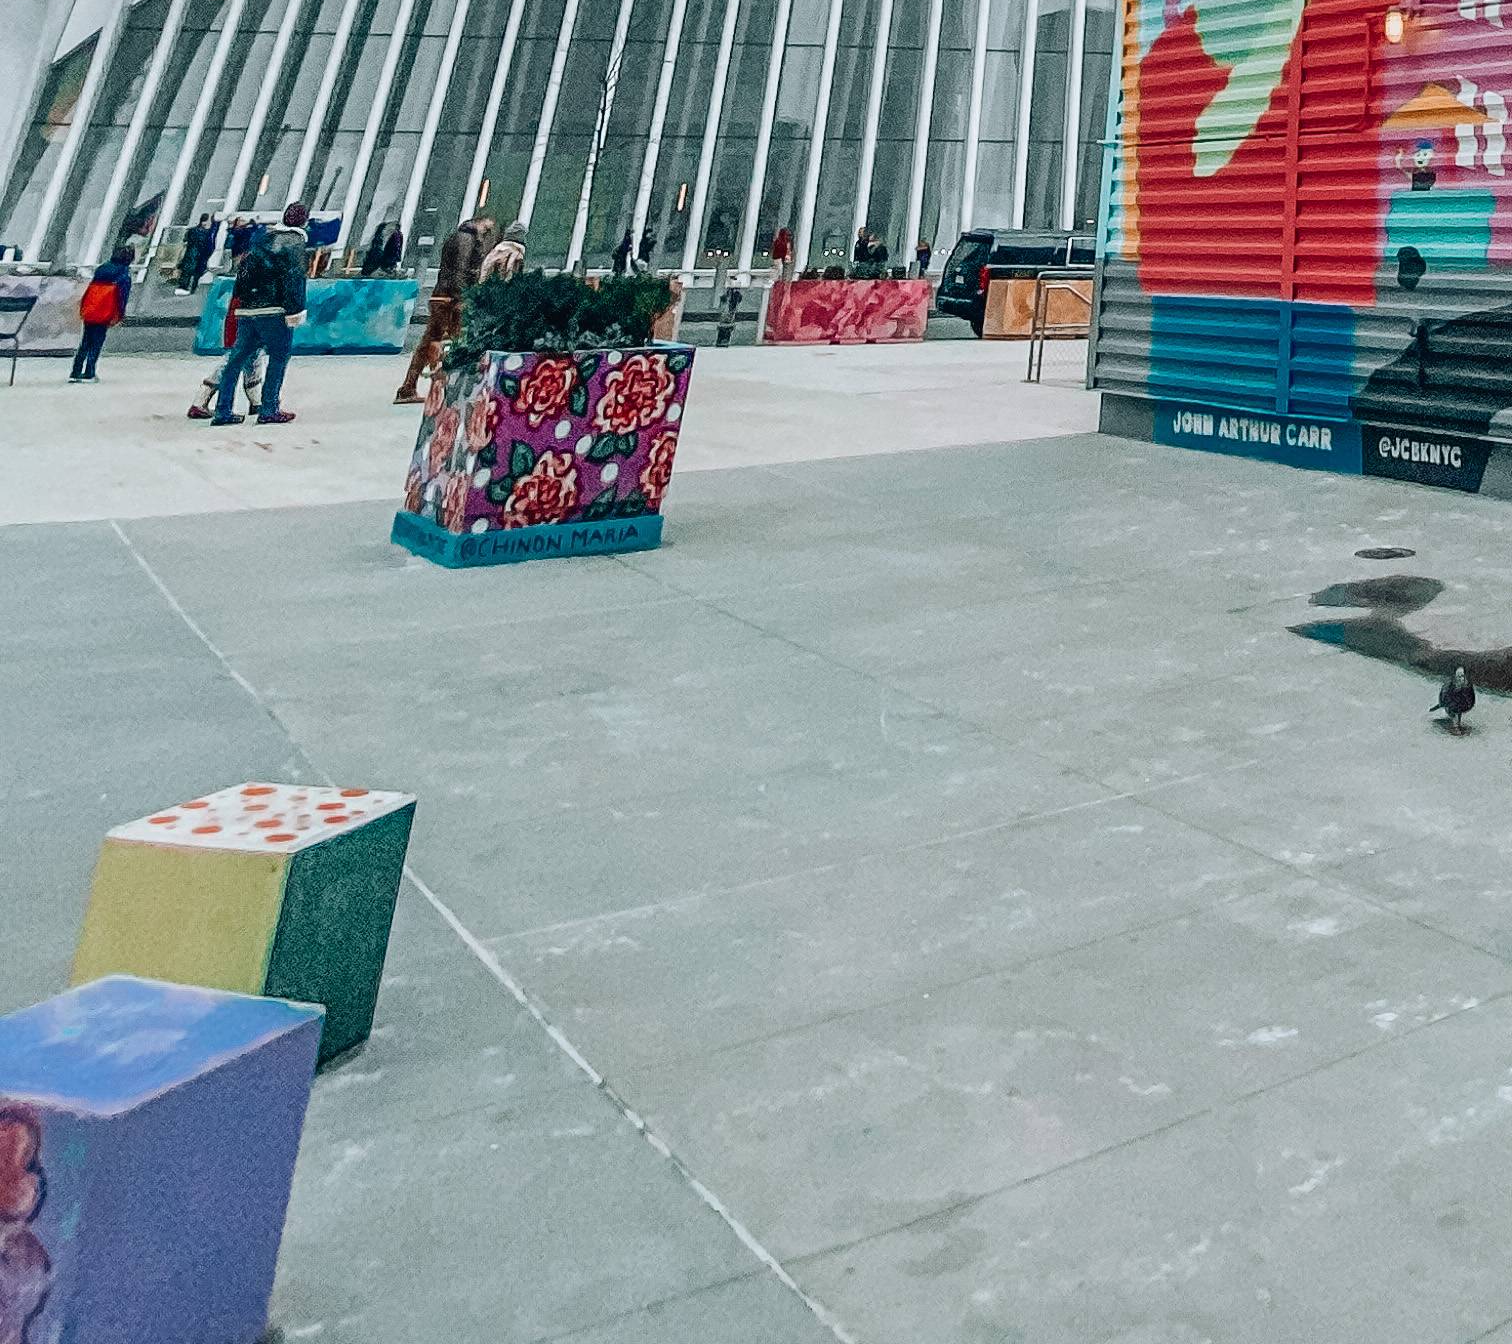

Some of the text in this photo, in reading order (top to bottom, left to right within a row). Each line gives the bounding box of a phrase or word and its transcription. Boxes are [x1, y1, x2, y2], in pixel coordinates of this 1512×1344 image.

[1172, 411, 1333, 451] JOHN ARTHUR CARR
[1378, 436, 1462, 468] @JCBKNYC
[460, 533, 563, 562] @CHINON
[570, 524, 639, 548] MARIA
